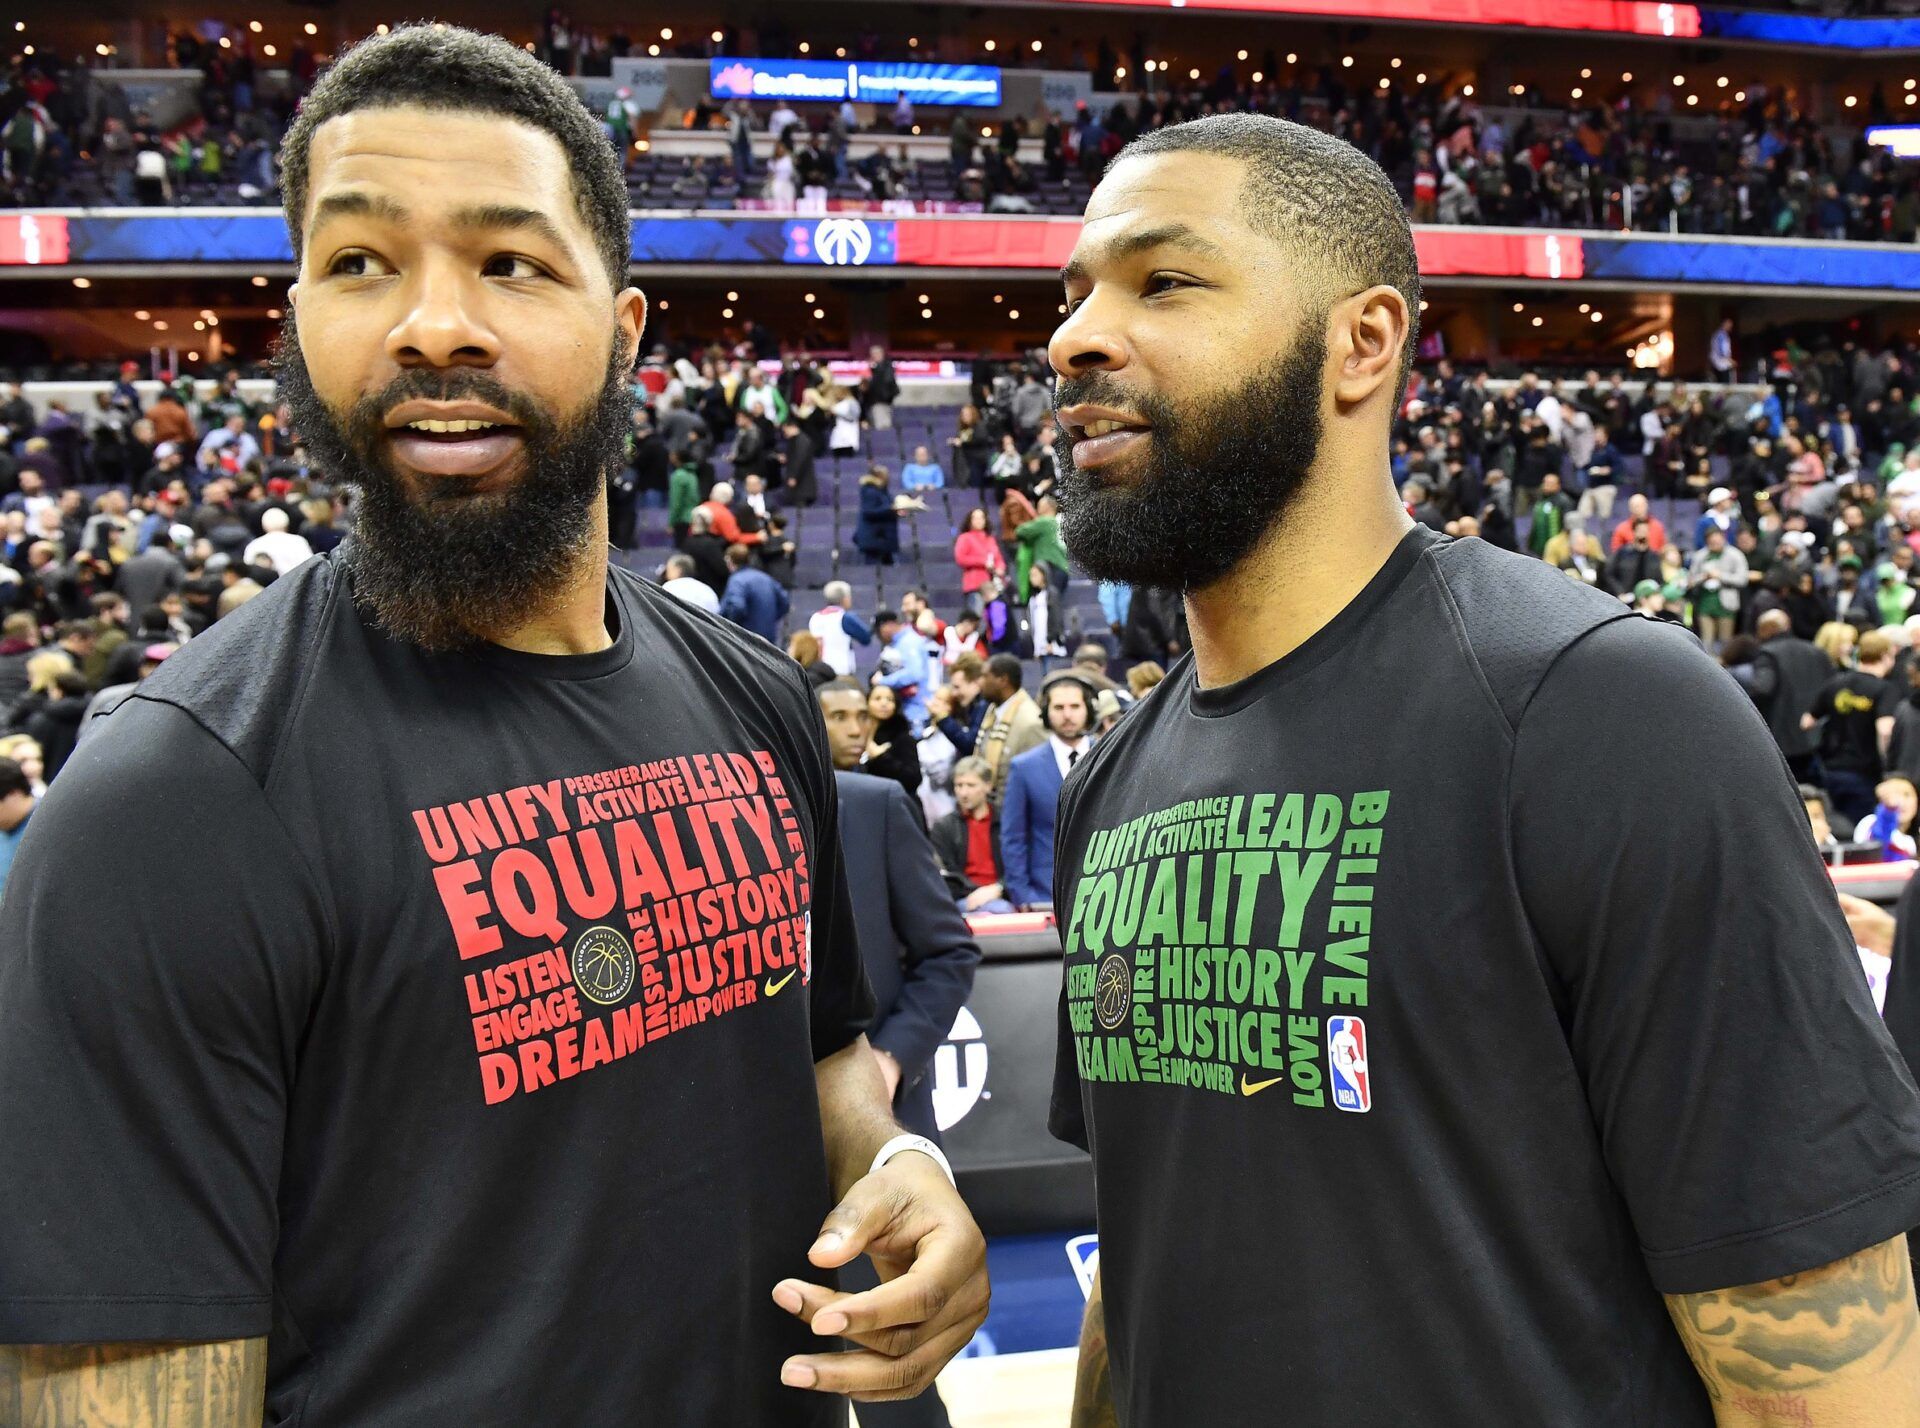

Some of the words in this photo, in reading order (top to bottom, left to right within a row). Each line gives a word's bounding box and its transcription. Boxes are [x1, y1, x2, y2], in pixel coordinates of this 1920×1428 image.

[565, 758, 679, 796] PERSEVERANCE
[576, 776, 689, 826] ACTIVATE
[676, 751, 759, 803] LEAD
[412, 779, 571, 863] UNIFY
[751, 750, 810, 905] BELIEVE
[1082, 813, 1153, 875] UNIFY
[1144, 818, 1226, 859] ACTIVATE
[1151, 796, 1230, 829] PERSEVERANCE
[1226, 793, 1344, 849] LEAD
[432, 794, 783, 960] EQUALITY
[653, 868, 799, 952] HISTORY
[1066, 851, 1332, 960] EQUALITY
[1322, 790, 1391, 1007] BELIEVE
[463, 946, 573, 1015] LISTEN
[626, 907, 670, 1043] INSPIRE
[667, 920, 796, 1004] JUSTICE
[1159, 947, 1316, 1010] HISTORY
[472, 986, 582, 1053] ENGAGE
[669, 980, 758, 1032] EMPOWER
[1132, 948, 1162, 1083] INSPIRE
[1158, 1003, 1284, 1071] JUSTICE
[478, 1002, 645, 1106] DREAM
[1074, 1036, 1141, 1083] REAM
[1161, 1057, 1237, 1096] EMPOWER
[1288, 1015, 1325, 1109] LOVE
[1337, 1088, 1357, 1106] NBA
